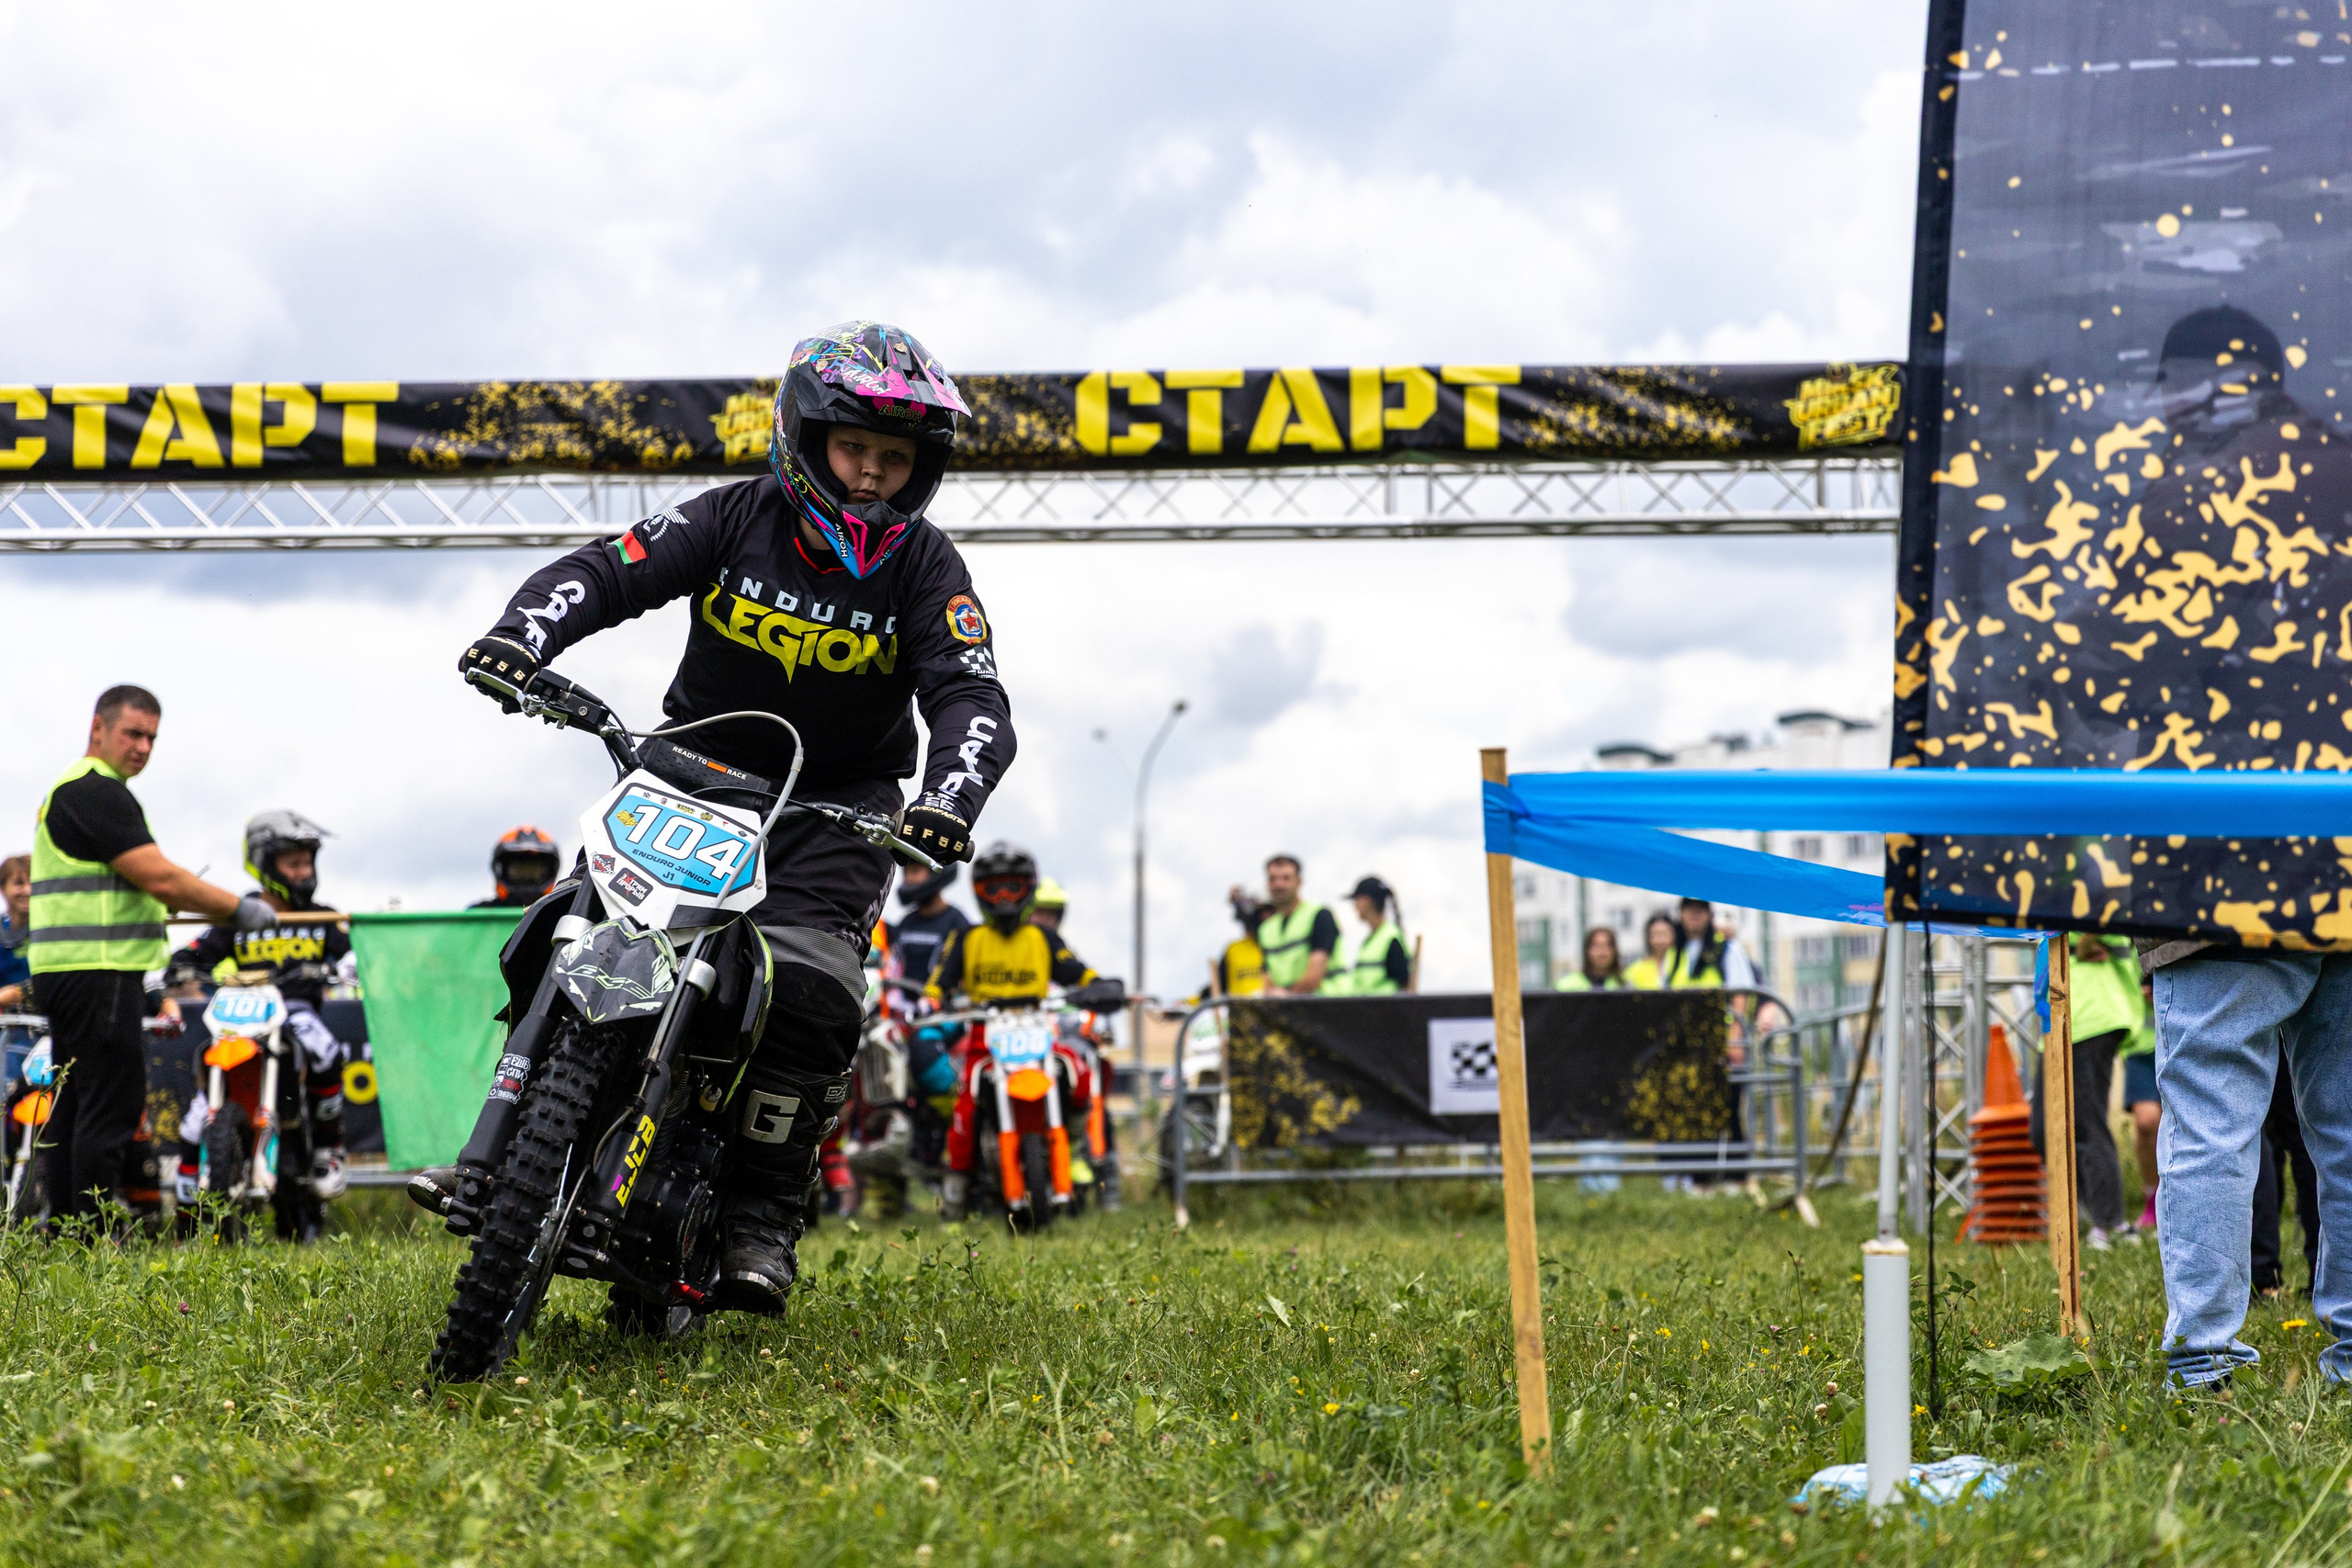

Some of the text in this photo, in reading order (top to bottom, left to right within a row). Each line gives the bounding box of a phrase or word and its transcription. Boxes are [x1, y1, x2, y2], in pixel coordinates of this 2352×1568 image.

[878, 404, 922, 423] AIROH
[1076, 366, 1521, 455] СТАРТ
[835, 522, 849, 558] AIROH
[703, 582, 899, 684] LEGION
[673, 746, 747, 780] READY TO RACE
[626, 805, 746, 881] 104
[632, 849, 712, 886] ENDURO JUNIOR
[662, 872, 675, 881] J1
[616, 878, 645, 900] ПРОРЫВ
[223, 995, 270, 1018] 101
[506, 1067, 525, 1081] СПИ
[510, 1056, 529, 1070] ЕШЬ
[742, 1089, 800, 1145] G
